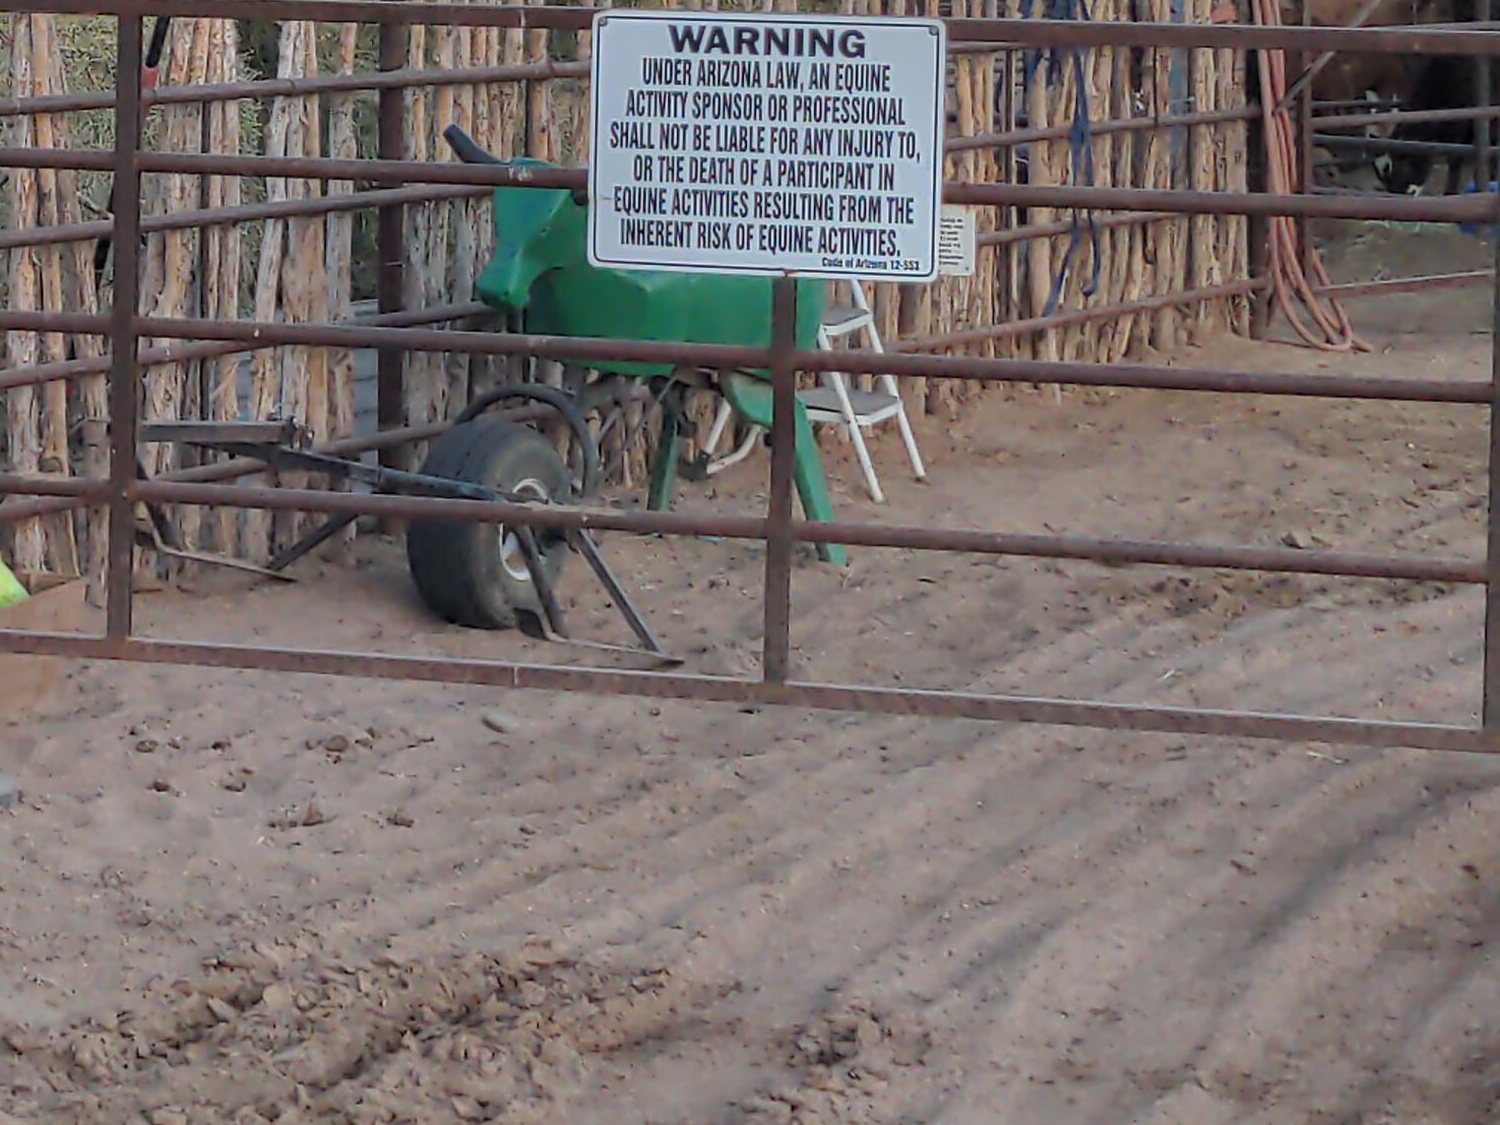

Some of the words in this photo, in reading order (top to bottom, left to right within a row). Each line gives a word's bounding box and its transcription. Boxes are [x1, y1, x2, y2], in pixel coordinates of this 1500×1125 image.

[668, 24, 867, 58] WARNING
[642, 57, 692, 87] UNDER
[696, 59, 762, 89] ARIZONA
[766, 61, 804, 92] LAW,
[808, 62, 831, 91] AN
[835, 63, 891, 93] EQUINE
[625, 89, 689, 119] ACTIVITY
[691, 91, 763, 121] SPONSOR
[767, 93, 788, 122] OR
[792, 95, 906, 126] PROFESSIONAL
[609, 121, 655, 150] SHALL
[659, 123, 689, 151] NOT
[692, 124, 712, 152] BE
[715, 125, 766, 154] LIABLE
[769, 127, 798, 155] FOR
[802, 128, 834, 157] ANY
[837, 129, 894, 158] INJURY
[897, 131, 921, 163] TO,
[633, 154, 653, 182] OR
[657, 155, 685, 184] THE
[689, 156, 735, 185] DEATH
[739, 158, 759, 186] OF
[762, 159, 773, 187] A
[777, 159, 875, 191] PARTICIPANT
[878, 163, 895, 191] IN
[614, 185, 668, 217] EQUINE
[671, 188, 749, 219] ACTIVITIES
[753, 191, 834, 221] RESULTING
[839, 194, 882, 224] FROM
[886, 196, 914, 225] THE
[620, 218, 693, 248] INHERENT
[697, 221, 732, 250] RISK
[735, 223, 755, 251] OF
[758, 224, 814, 255] EQUINE
[817, 227, 901, 257] ACTIVITIES.
